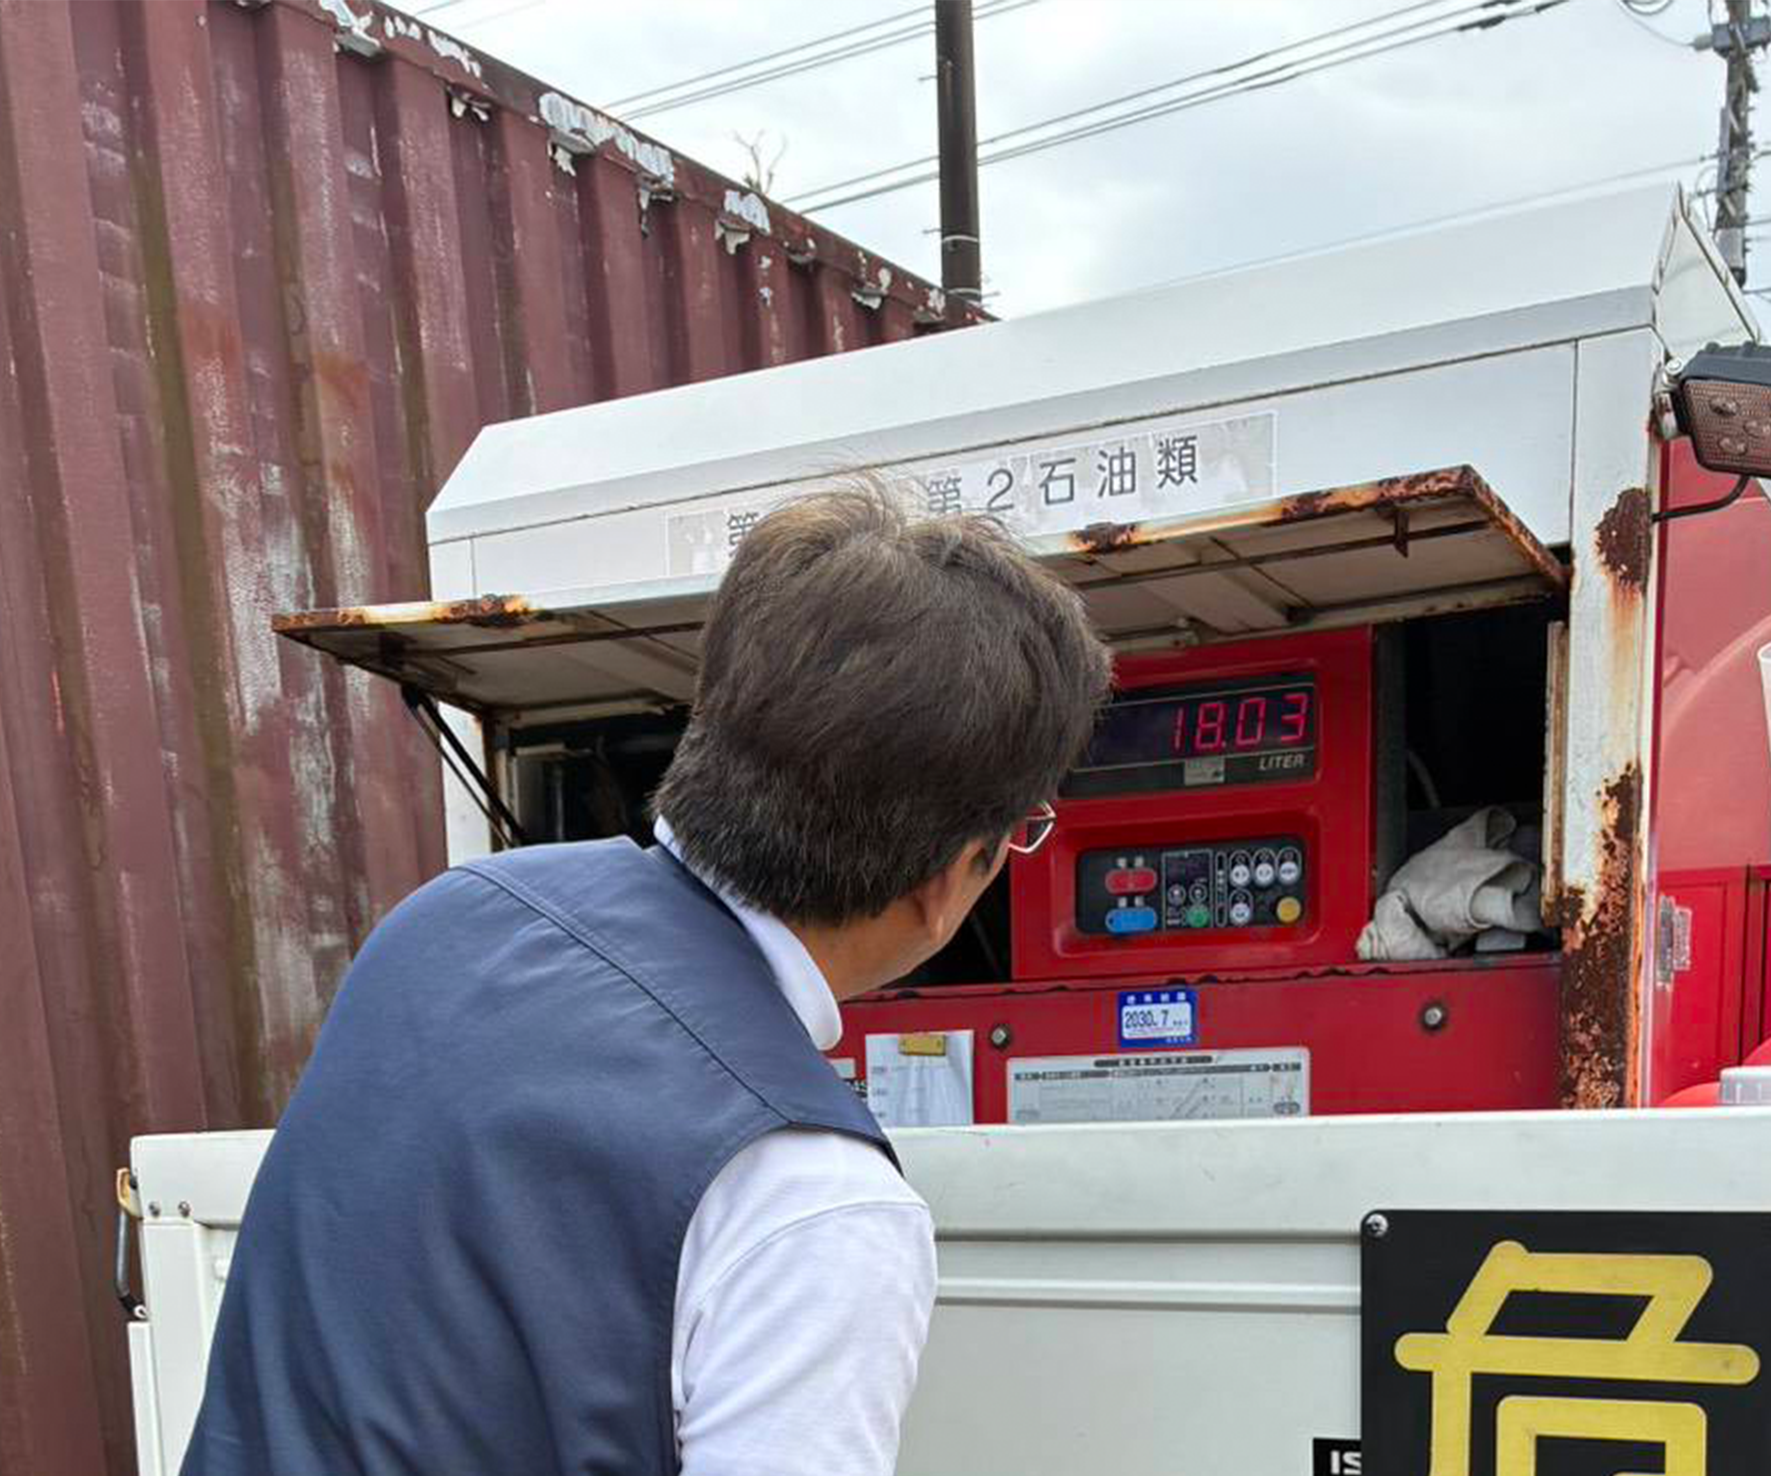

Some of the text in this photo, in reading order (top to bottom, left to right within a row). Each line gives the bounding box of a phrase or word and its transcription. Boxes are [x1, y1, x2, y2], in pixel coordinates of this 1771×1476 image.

[1174, 692, 1309, 750] 18.03
[1258, 753, 1306, 771] LITER
[1330, 1450, 1362, 1475] IS
